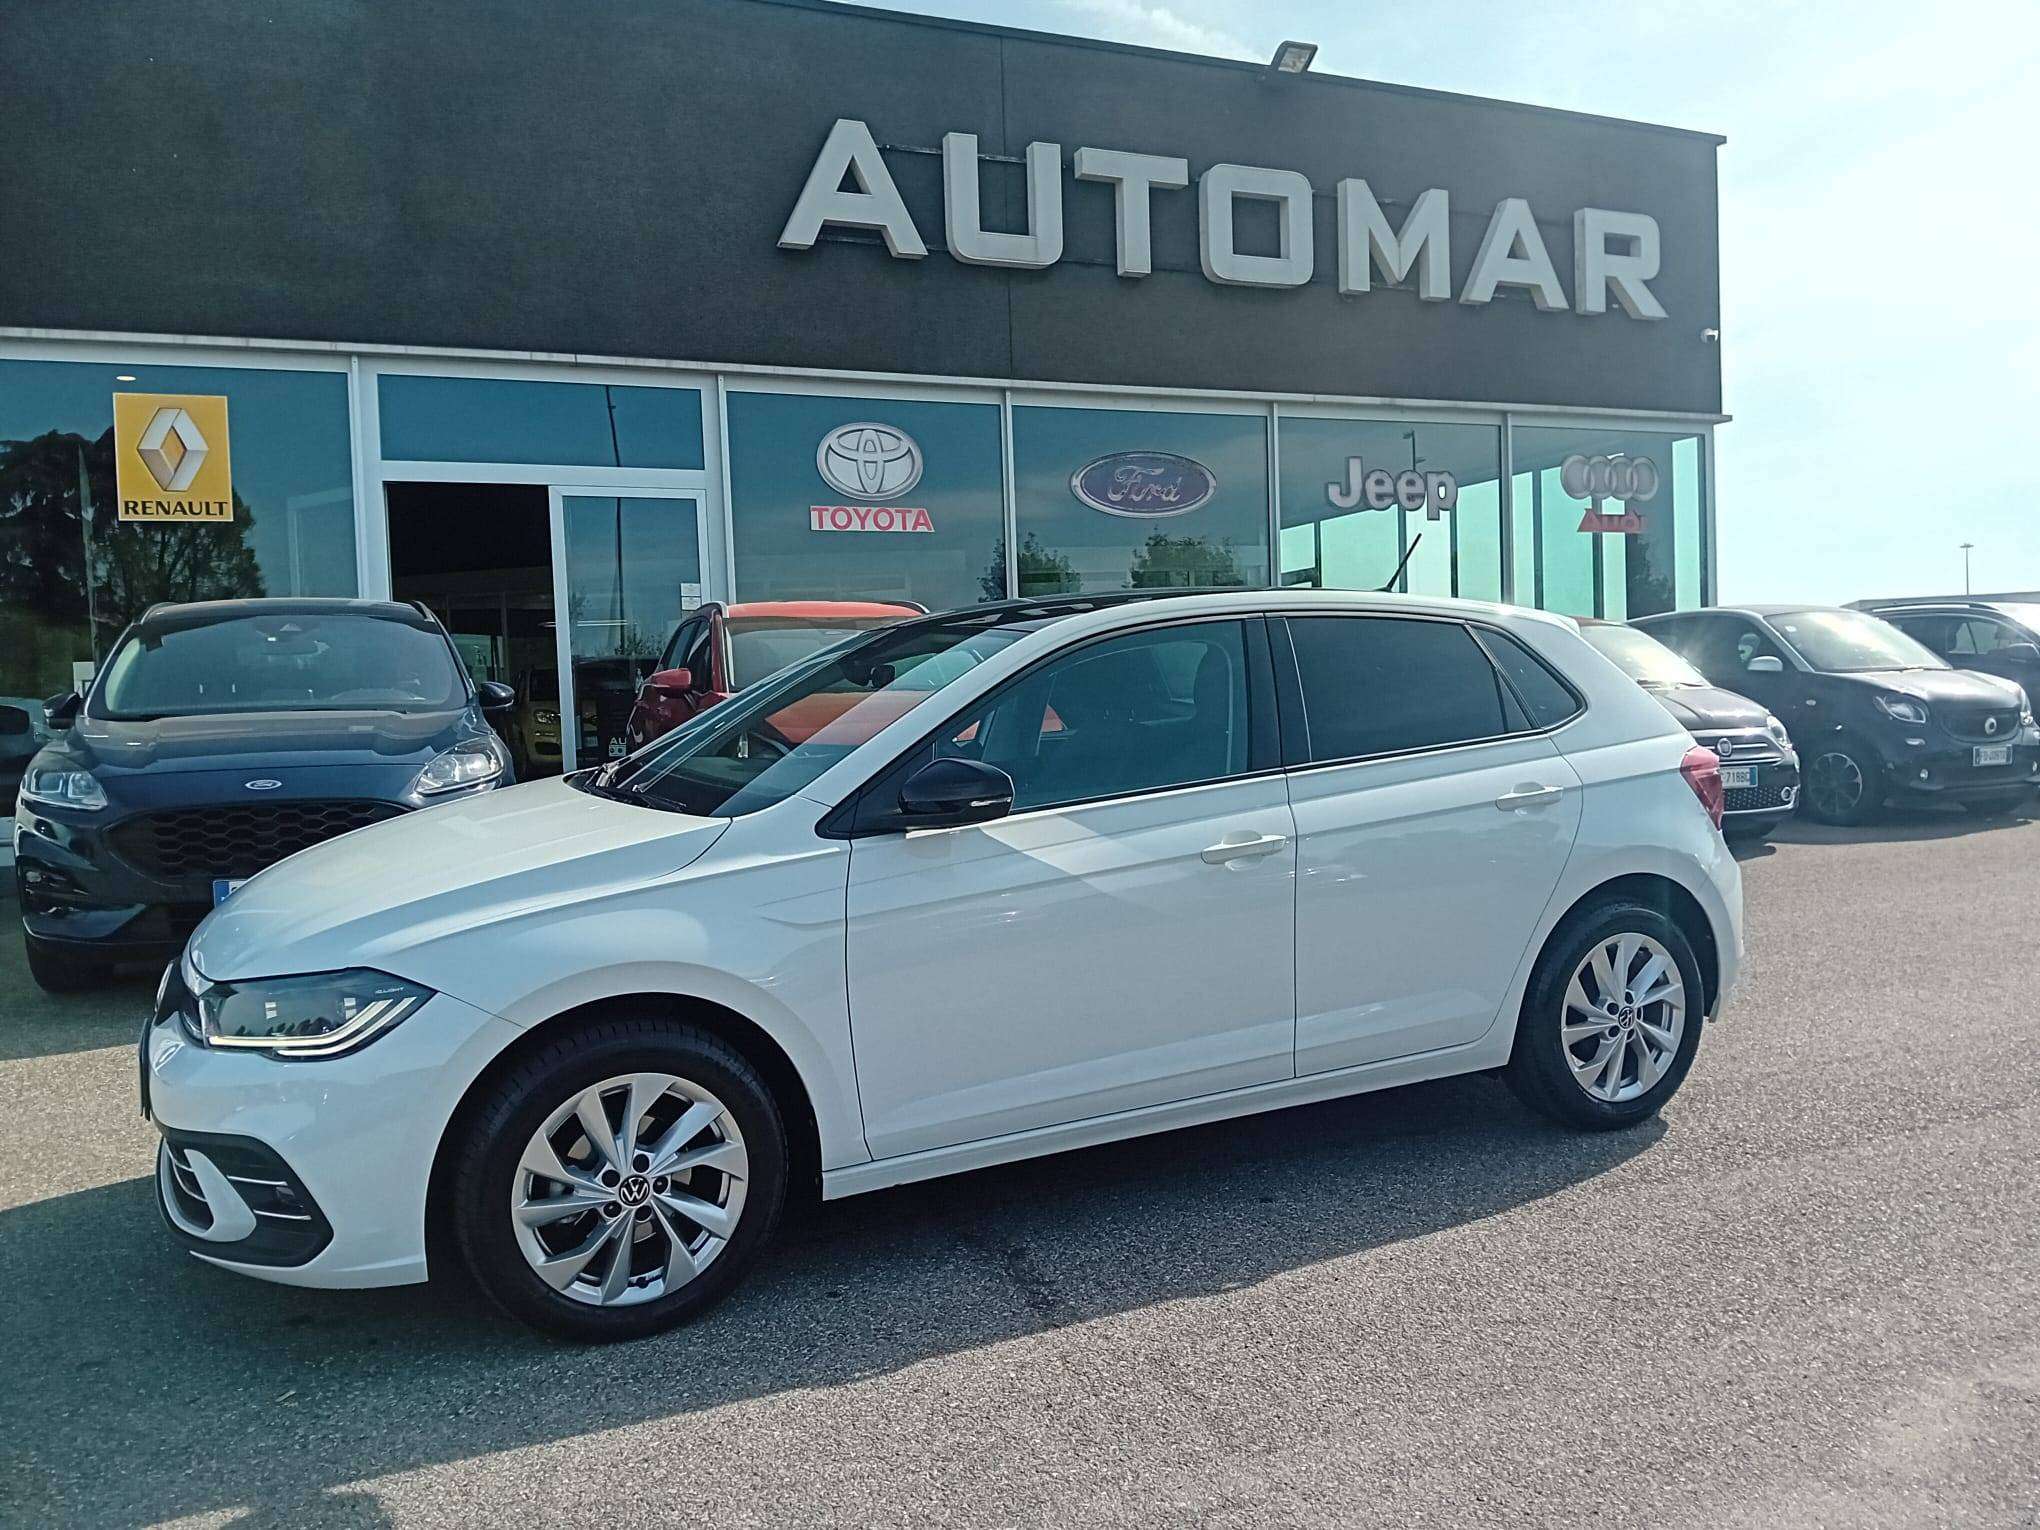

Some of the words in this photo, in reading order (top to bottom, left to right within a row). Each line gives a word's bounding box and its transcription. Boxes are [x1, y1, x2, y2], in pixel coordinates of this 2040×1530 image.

[777, 118, 1669, 320] AUTOMAR
[1107, 465, 1183, 502] Ford
[1325, 455, 1457, 521] Jeep
[123, 500, 228, 516] RENAULT
[811, 506, 933, 532] TOYOTA
